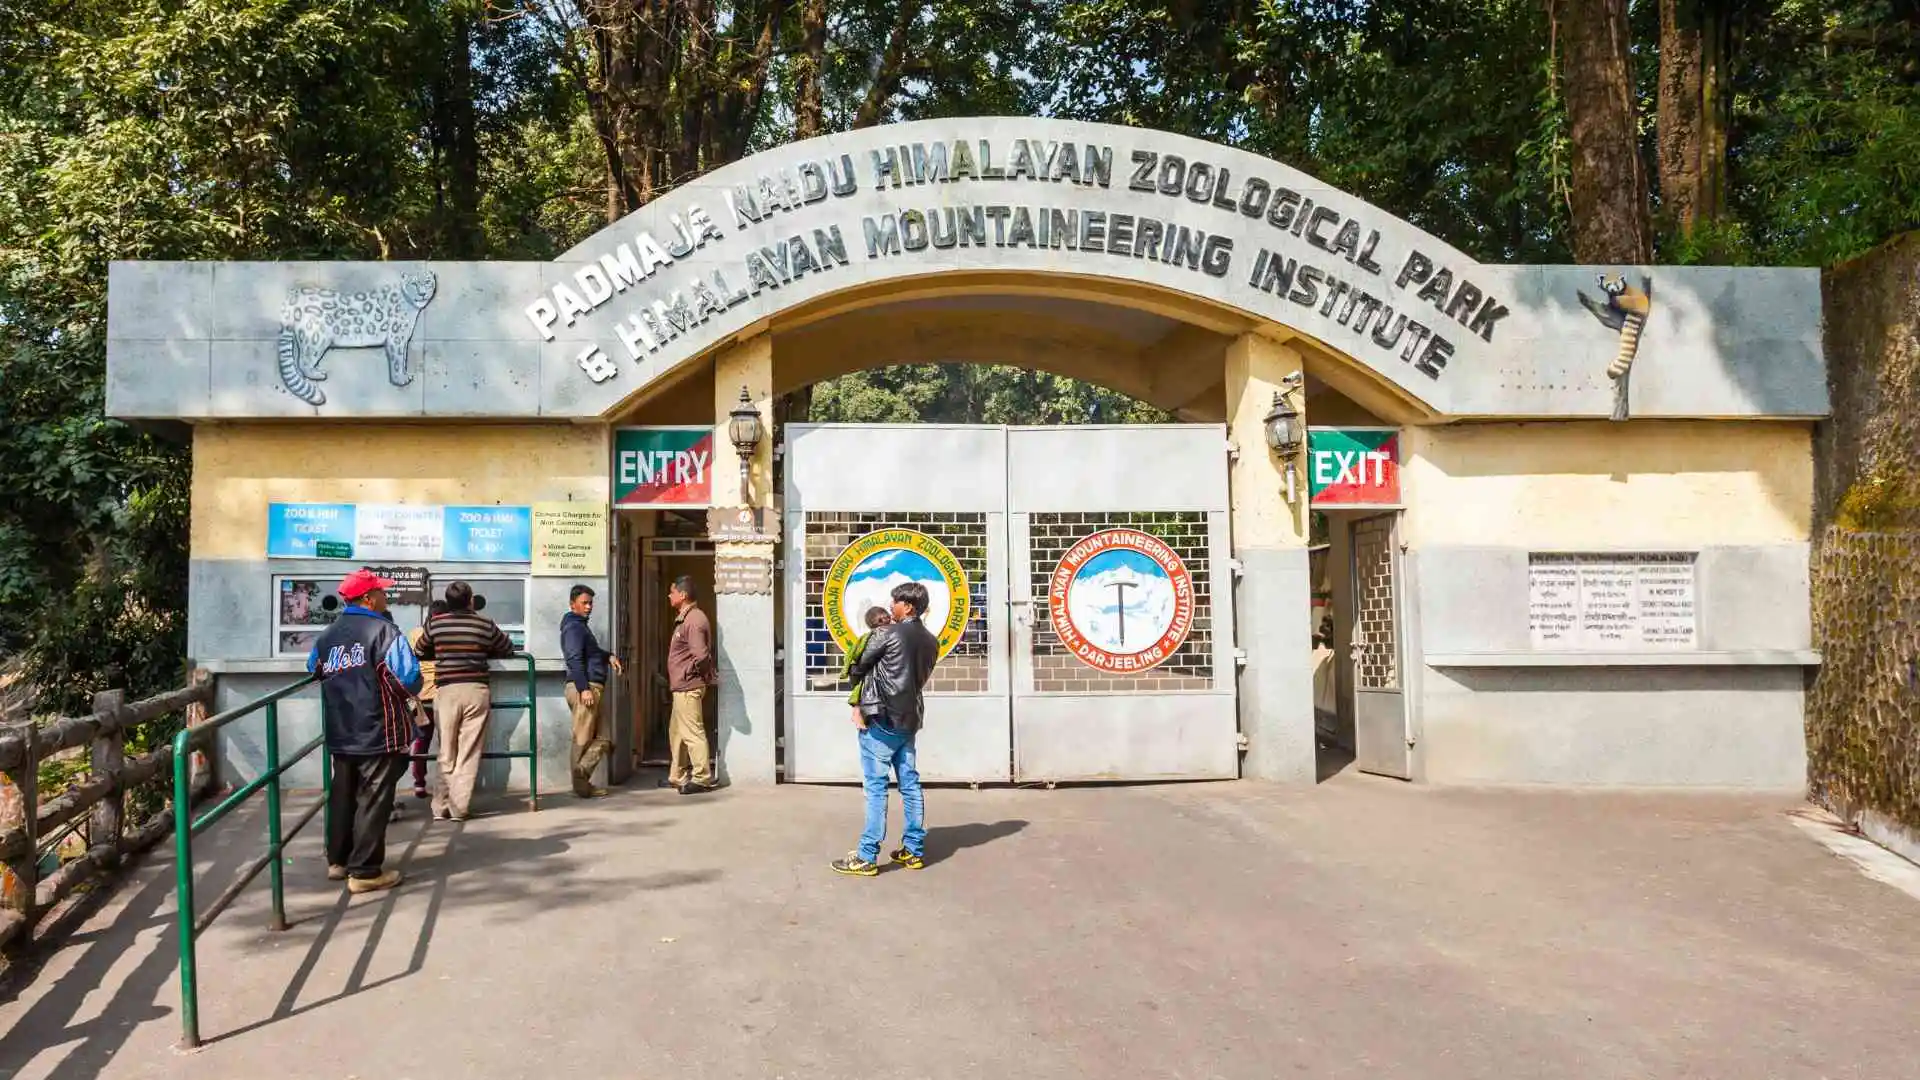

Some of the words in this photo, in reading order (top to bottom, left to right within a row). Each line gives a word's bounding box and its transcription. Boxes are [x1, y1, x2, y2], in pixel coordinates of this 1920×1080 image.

[525, 203, 725, 342] PADMAJA
[726, 153, 858, 231] NAIDU
[870, 139, 1113, 190] HIMALAYAN
[1129, 150, 1382, 276] ZOOLOGICAL
[1395, 249, 1510, 343] PARK
[576, 343, 618, 383] &
[614, 223, 849, 364] HIMALAYAN
[862, 205, 1234, 277] MOUNTAINEERING
[1249, 247, 1456, 381] INSTITUTE
[620, 450, 709, 486] ENTRY
[1315, 450, 1390, 485] EXIT
[916, 537, 963, 593] ZOOLOGICAL
[949, 597, 966, 632] PARK
[1066, 532, 1179, 572] MOUNTAINEERING
[1170, 574, 1190, 643] INSTITUTE
[323, 643, 367, 673] Mets
[1078, 643, 1164, 669] DARJEELING
